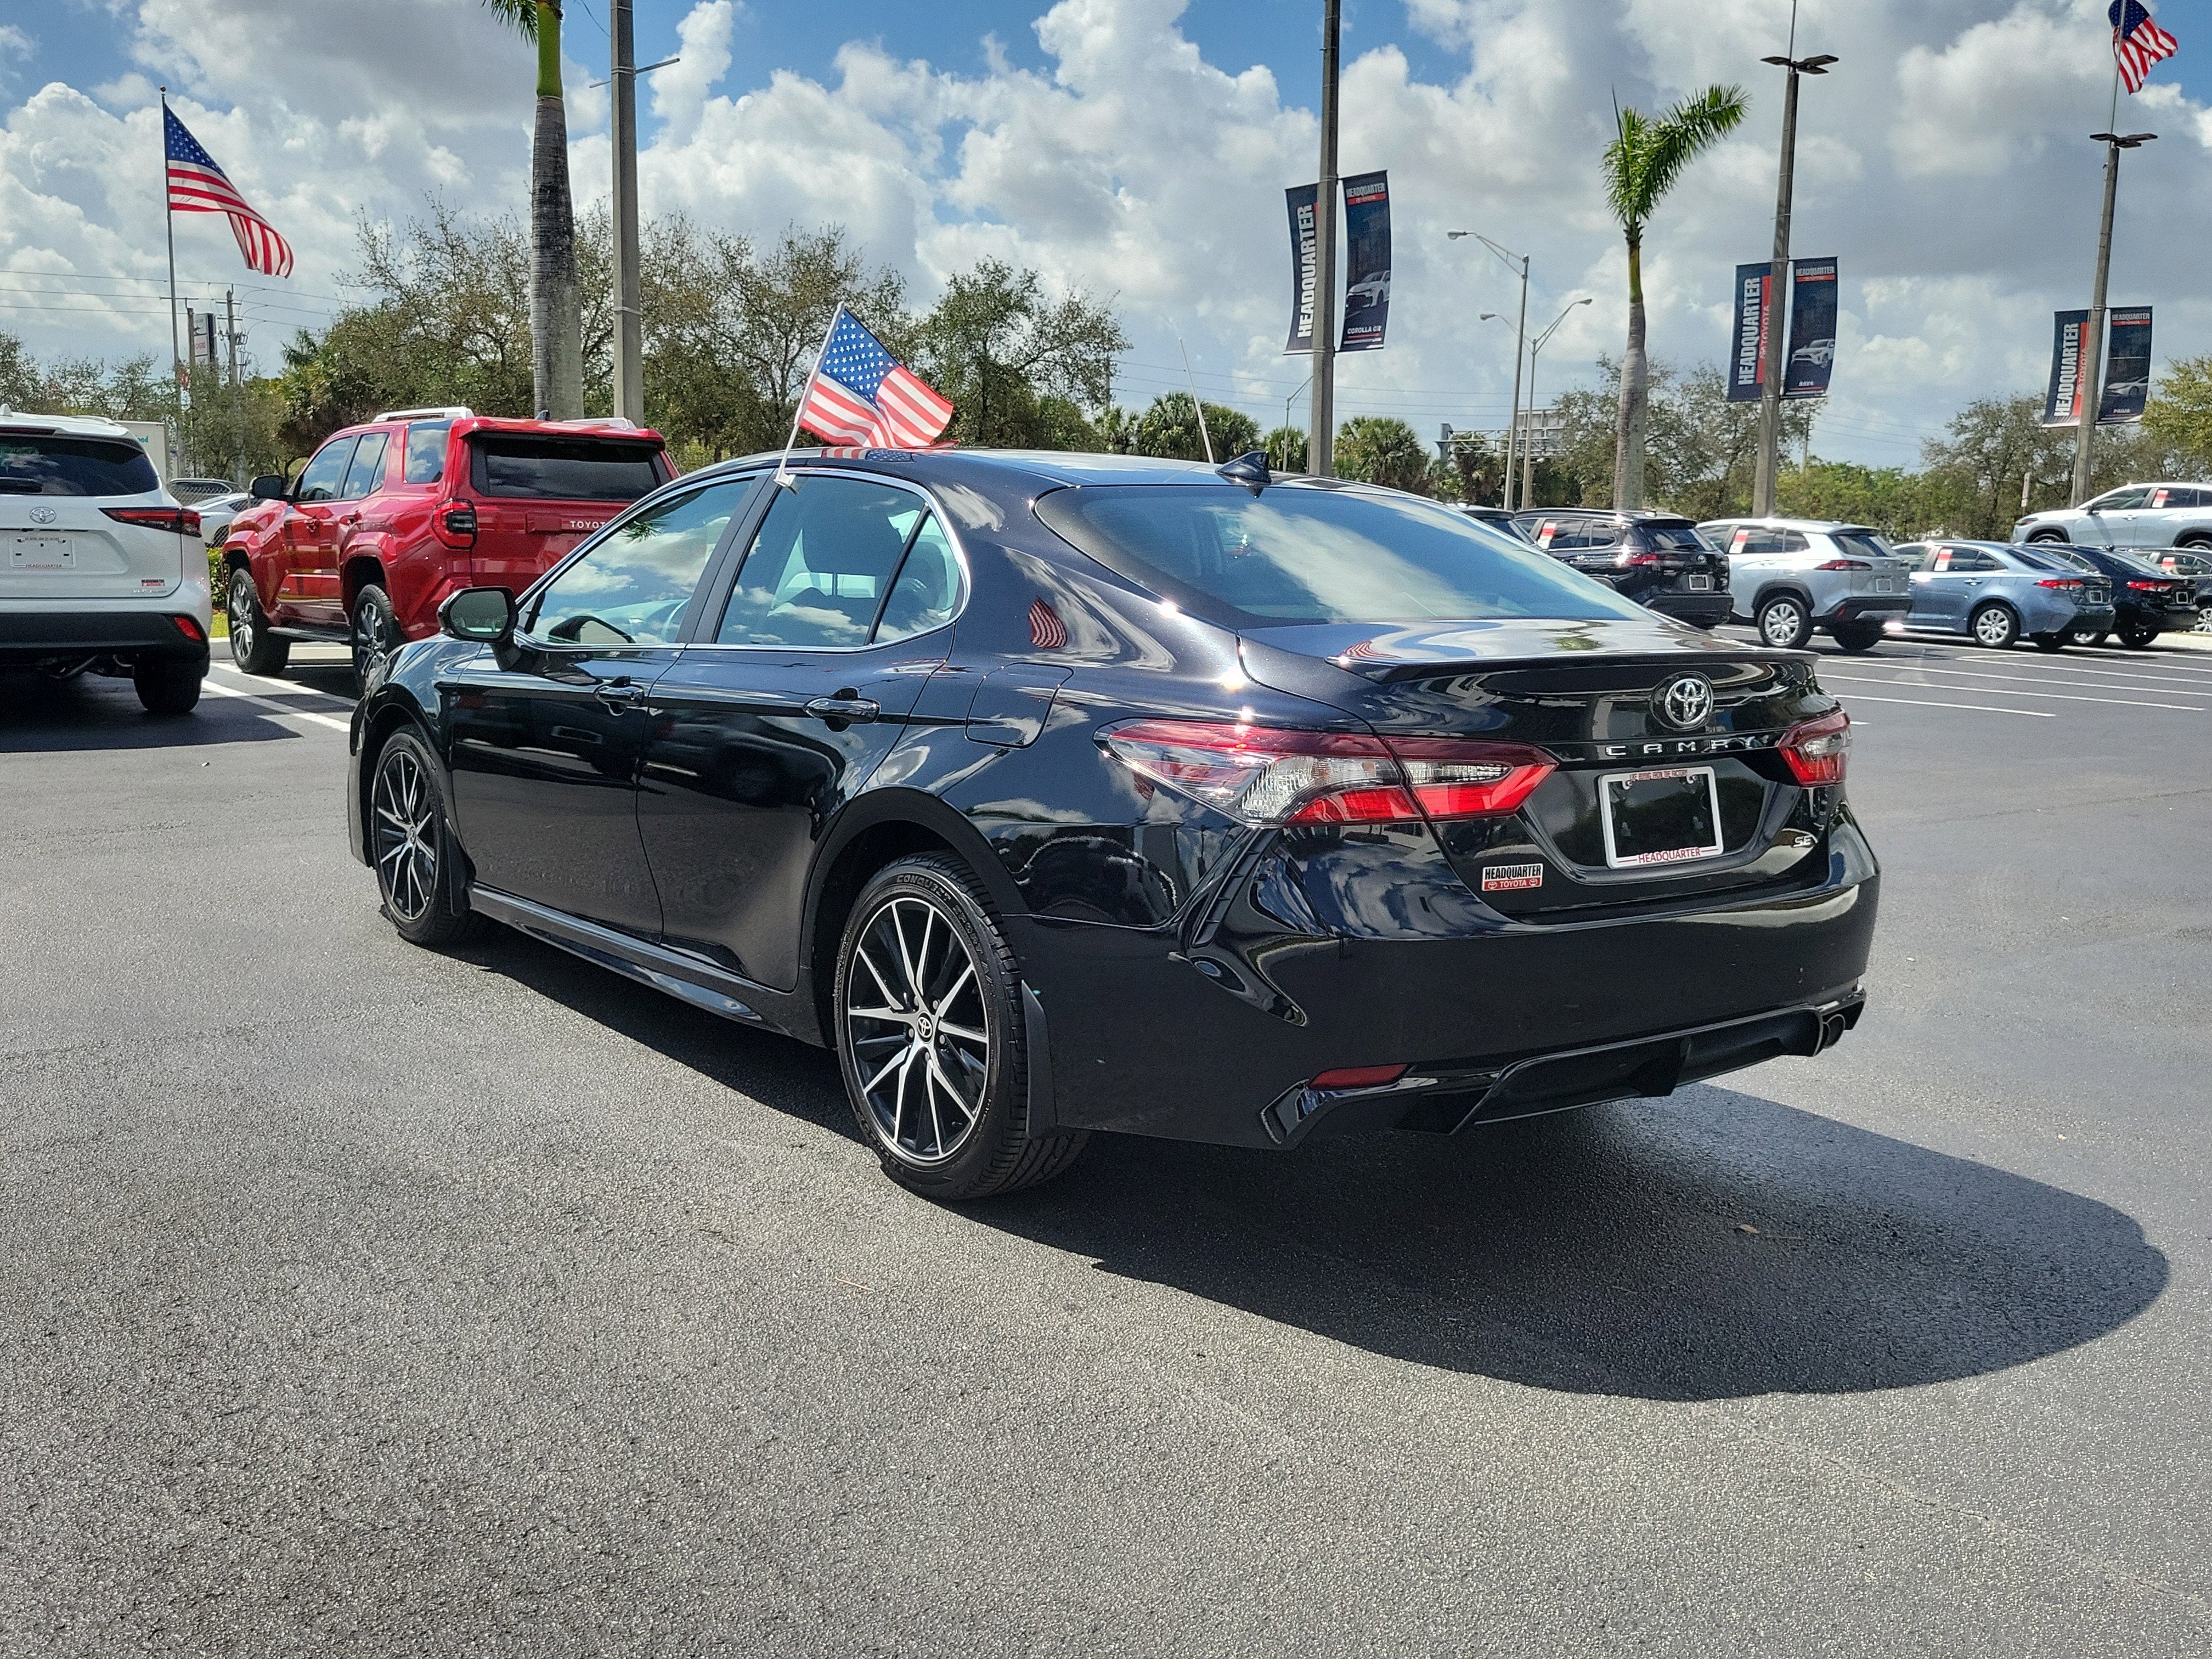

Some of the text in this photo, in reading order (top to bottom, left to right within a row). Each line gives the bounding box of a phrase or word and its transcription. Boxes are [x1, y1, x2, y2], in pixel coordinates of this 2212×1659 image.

[1296, 204, 1316, 338] HEADQUARTER
[1347, 326, 1372, 334] COROLLA
[1737, 276, 1760, 385] HEADQUARTER
[1761, 306, 1770, 345] TOYOTA
[2053, 323, 2079, 417] HEADQUARTER
[1605, 736, 1756, 756] CAMRY
[1793, 835, 1812, 847] SE
[1638, 848, 1701, 864] HEADQUARTER
[1485, 865, 1541, 879] HEADQUARTER
[896, 875, 951, 901] CONQUEST
[1499, 879, 1527, 888] TOYOTA
